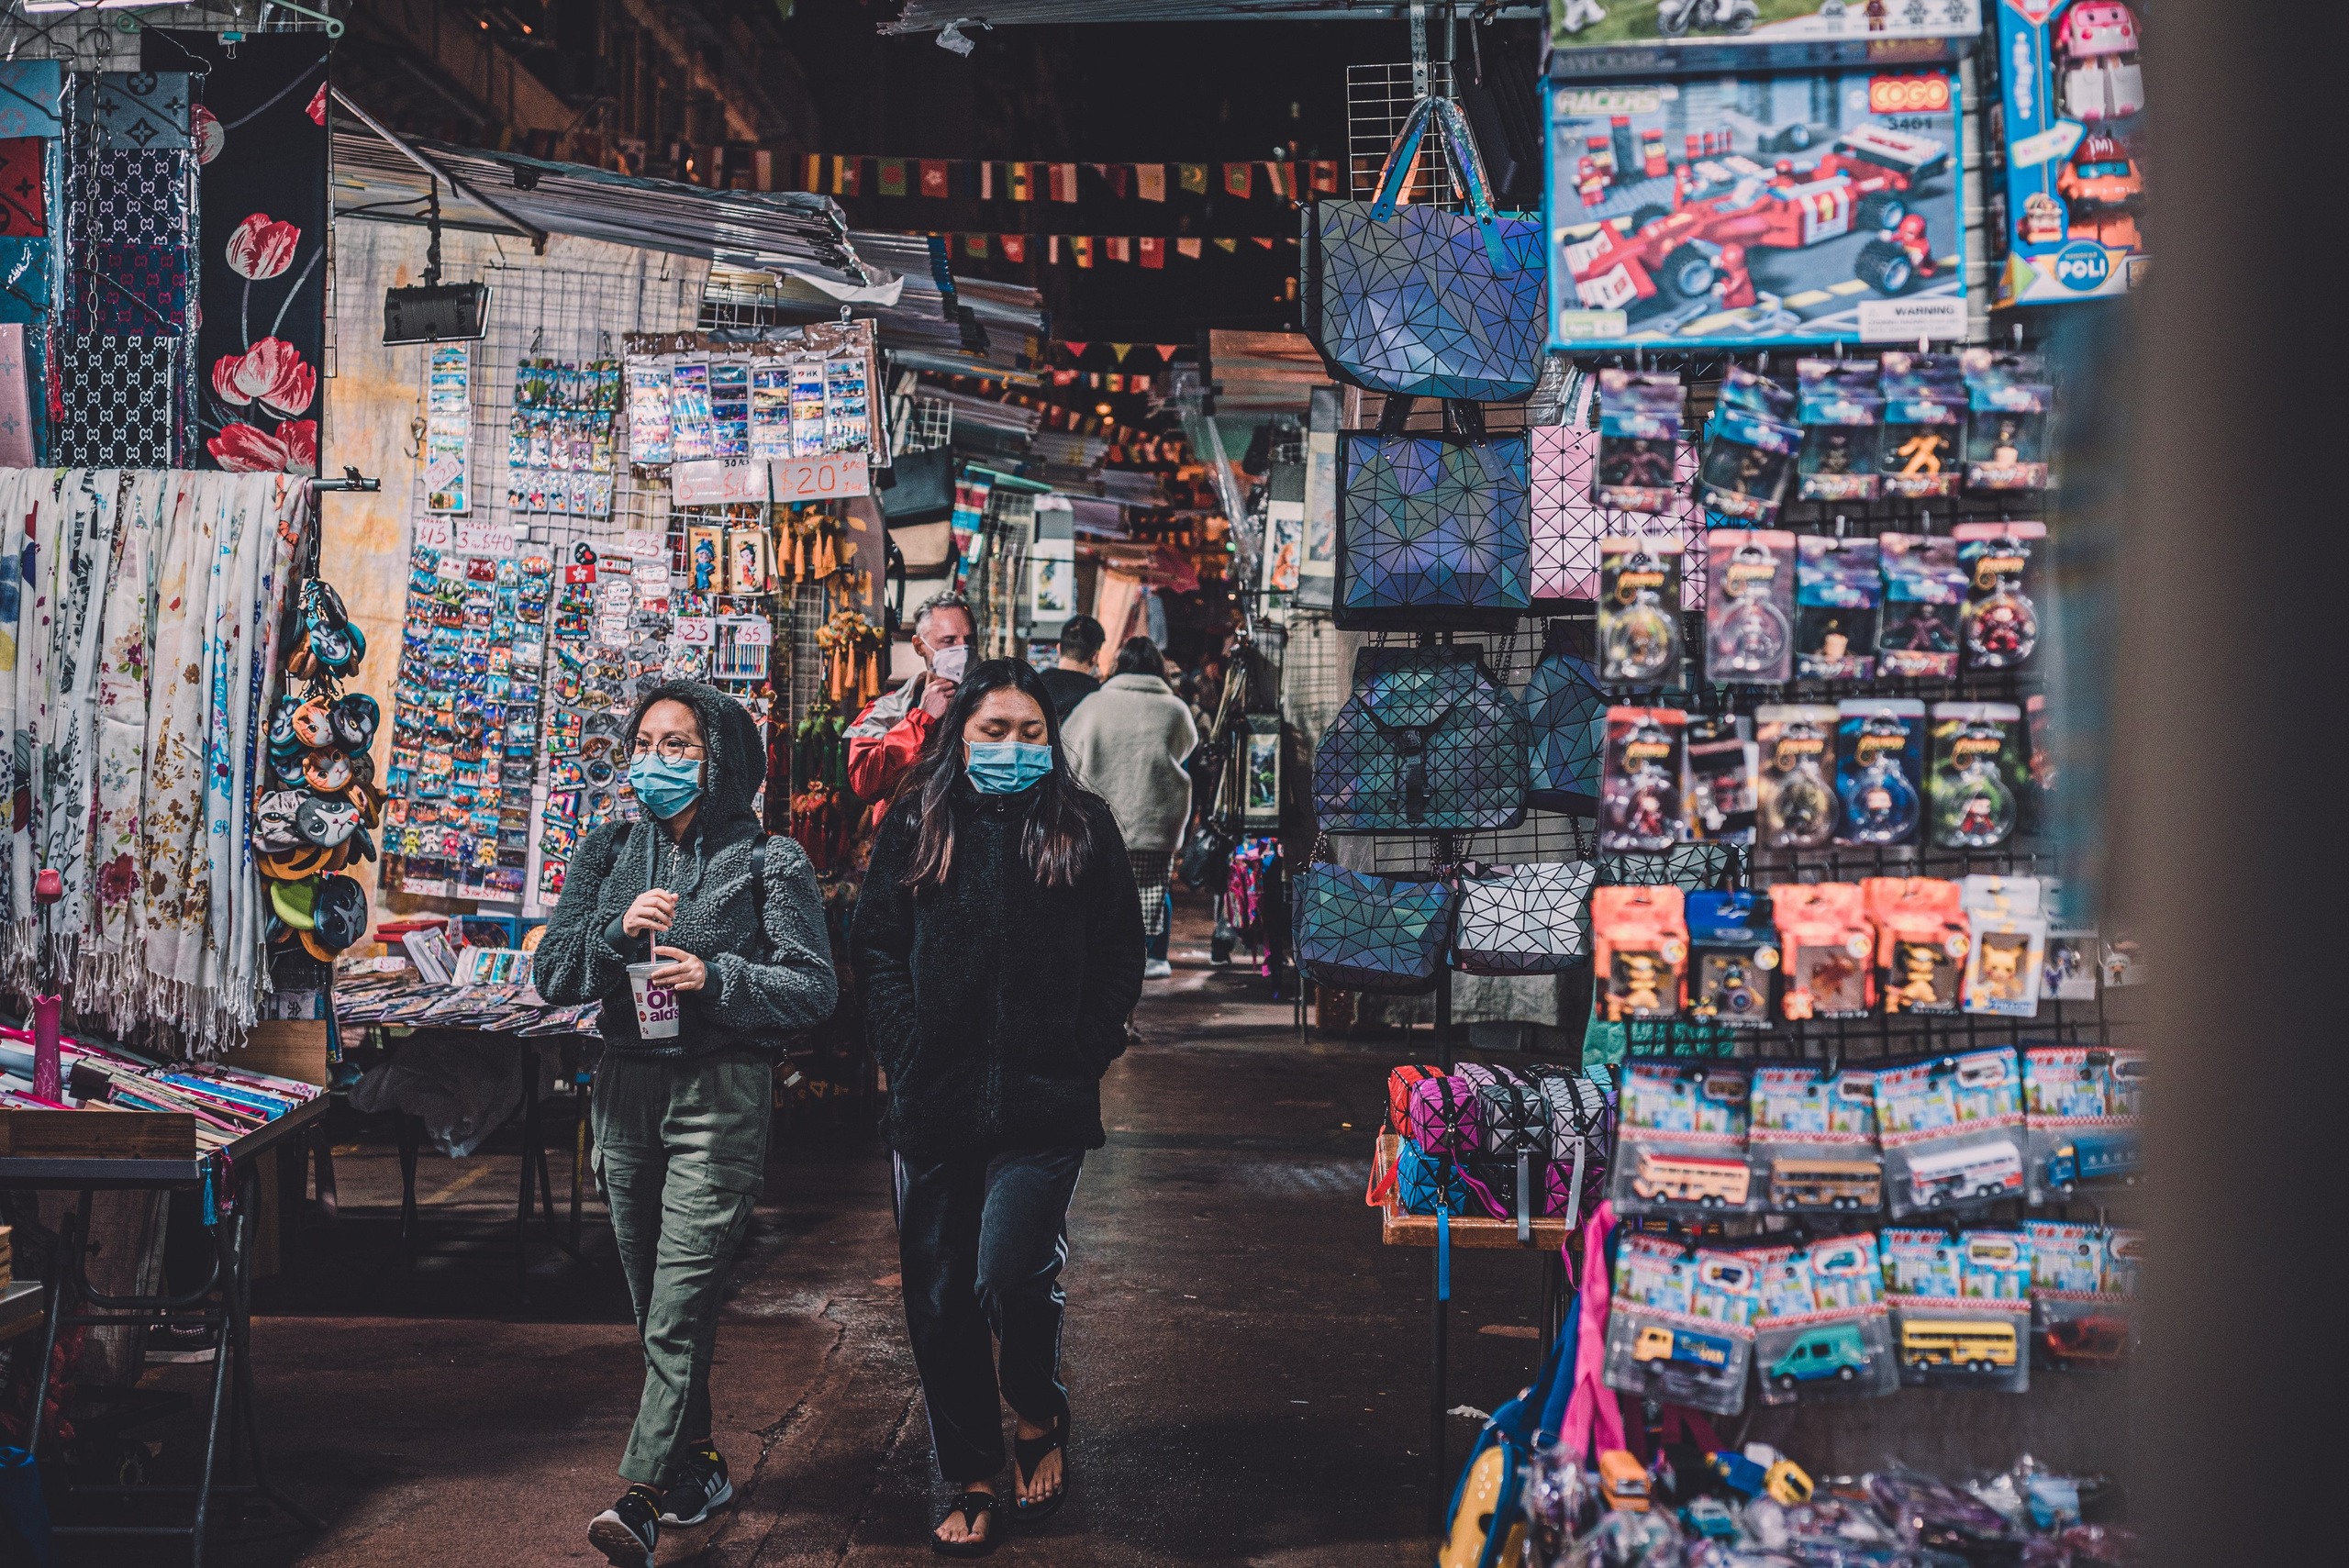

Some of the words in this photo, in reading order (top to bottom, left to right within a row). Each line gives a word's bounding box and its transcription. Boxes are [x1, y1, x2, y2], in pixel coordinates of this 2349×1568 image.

[1562, 90, 1659, 114] RACERS
[1870, 80, 1949, 111] COGO
[2058, 259, 2106, 279] POLI
[1896, 305, 1955, 316] WARNING
[806, 370, 818, 378] HK
[724, 459, 737, 468] 30
[738, 459, 750, 467] PCS
[431, 461, 458, 487] $20
[780, 464, 836, 496] $20
[679, 472, 694, 500] 6
[420, 526, 447, 544] $15
[457, 531, 469, 549] 3
[483, 532, 513, 551] $40
[614, 561, 629, 570] HK
[676, 624, 708, 641] $25
[736, 626, 762, 642] $65
[650, 1008, 679, 1022] ald's
[1699, 1347, 1726, 1365] VAN
